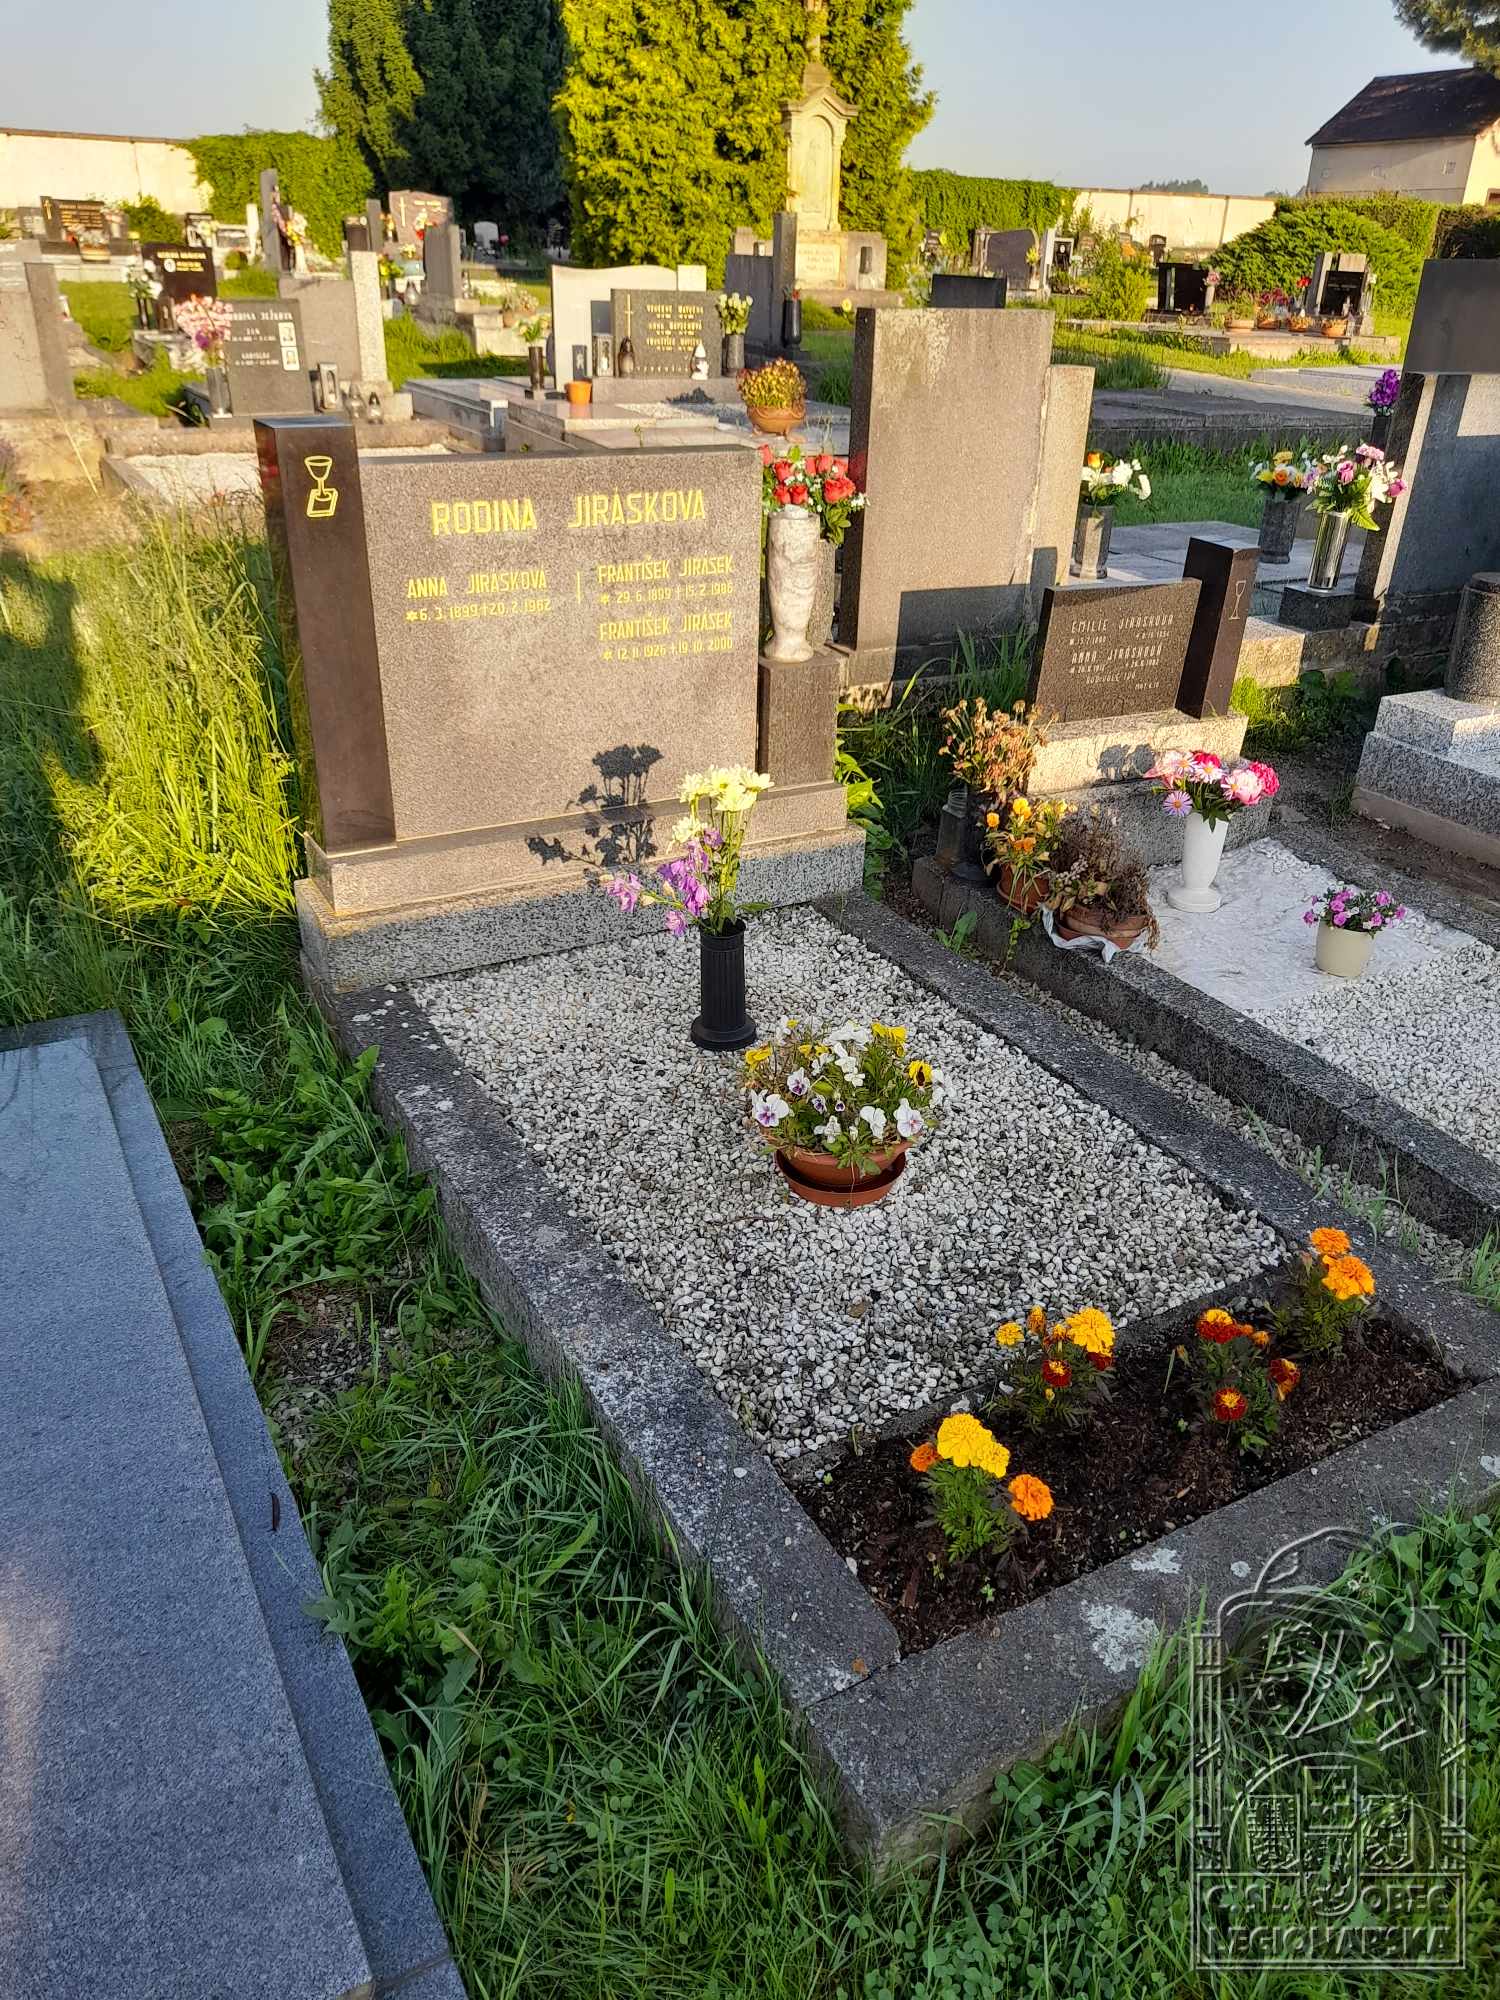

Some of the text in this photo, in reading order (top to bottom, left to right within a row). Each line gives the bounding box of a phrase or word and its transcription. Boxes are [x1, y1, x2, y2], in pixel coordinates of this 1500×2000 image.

[431, 497, 539, 536] RODINA
[596, 554, 671, 584] FRANTIŠEK
[407, 576, 448, 599] ANNA
[599, 610, 672, 641] FRANTIŠEK
[1072, 619, 1108, 634] EMILIE
